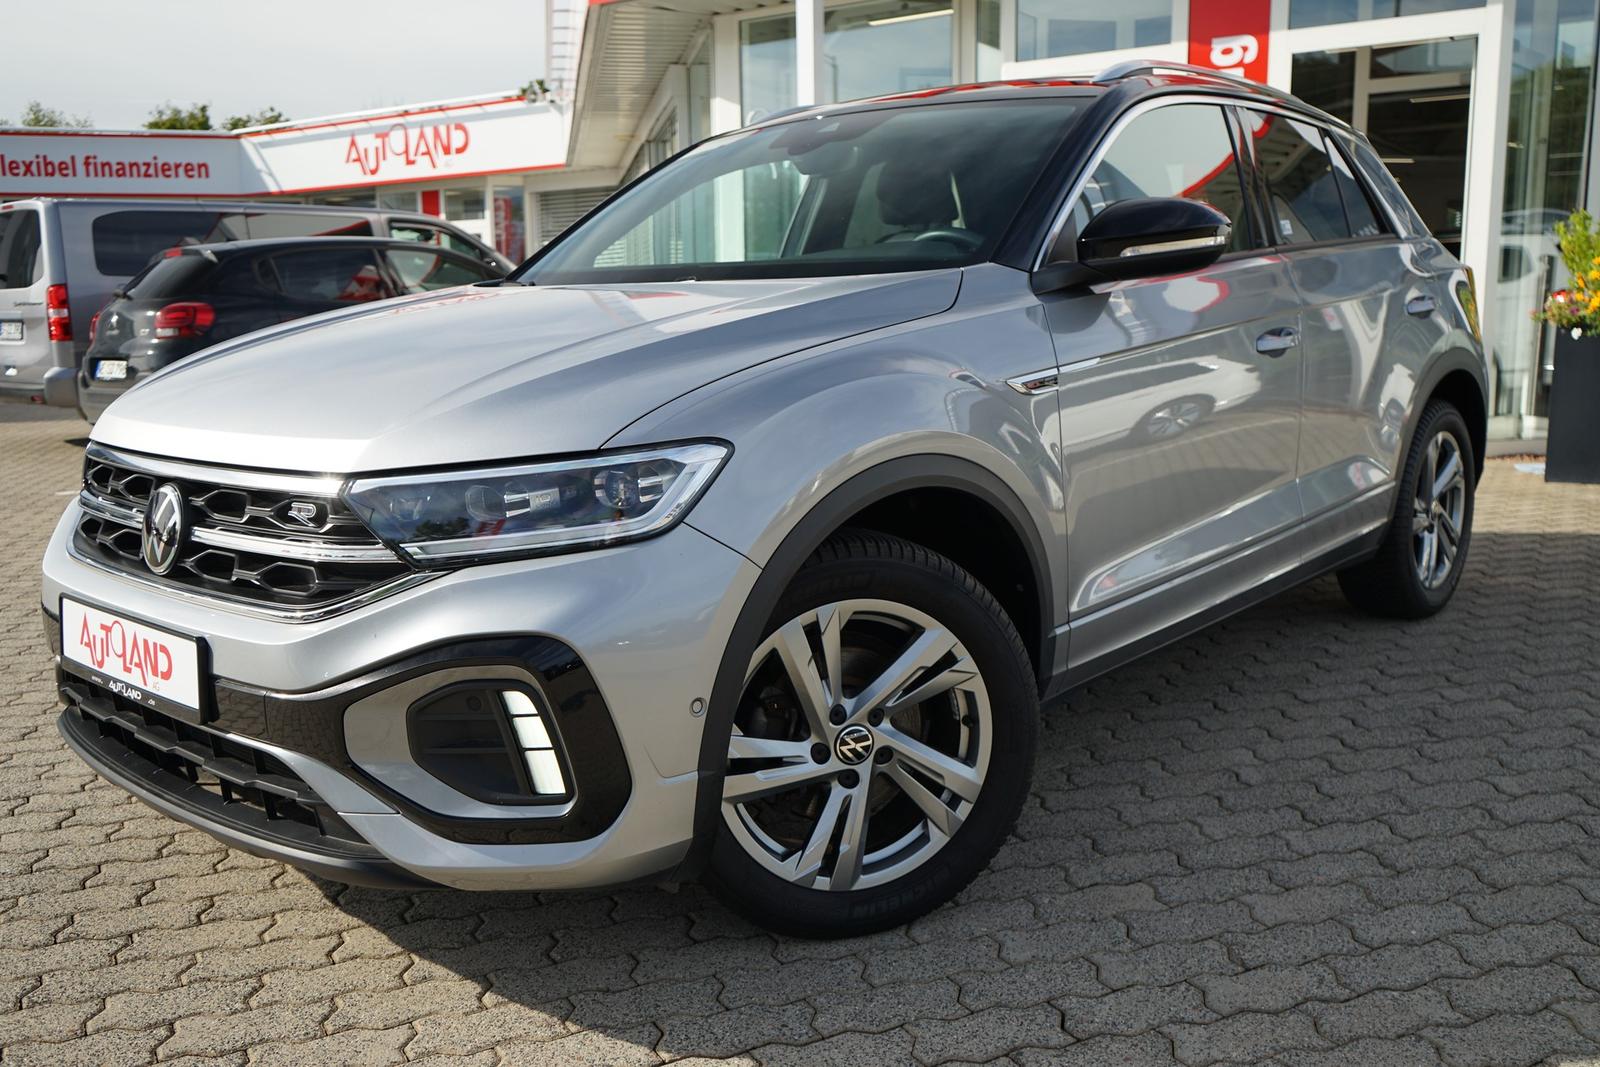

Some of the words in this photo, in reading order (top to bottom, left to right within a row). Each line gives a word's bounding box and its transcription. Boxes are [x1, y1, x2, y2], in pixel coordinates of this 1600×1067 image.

[83, 155, 210, 179] finanzieren
[345, 122, 470, 175] AUTOLAND
[80, 612, 173, 687] AUTOLAND
[108, 680, 142, 700] AUTOLAND
